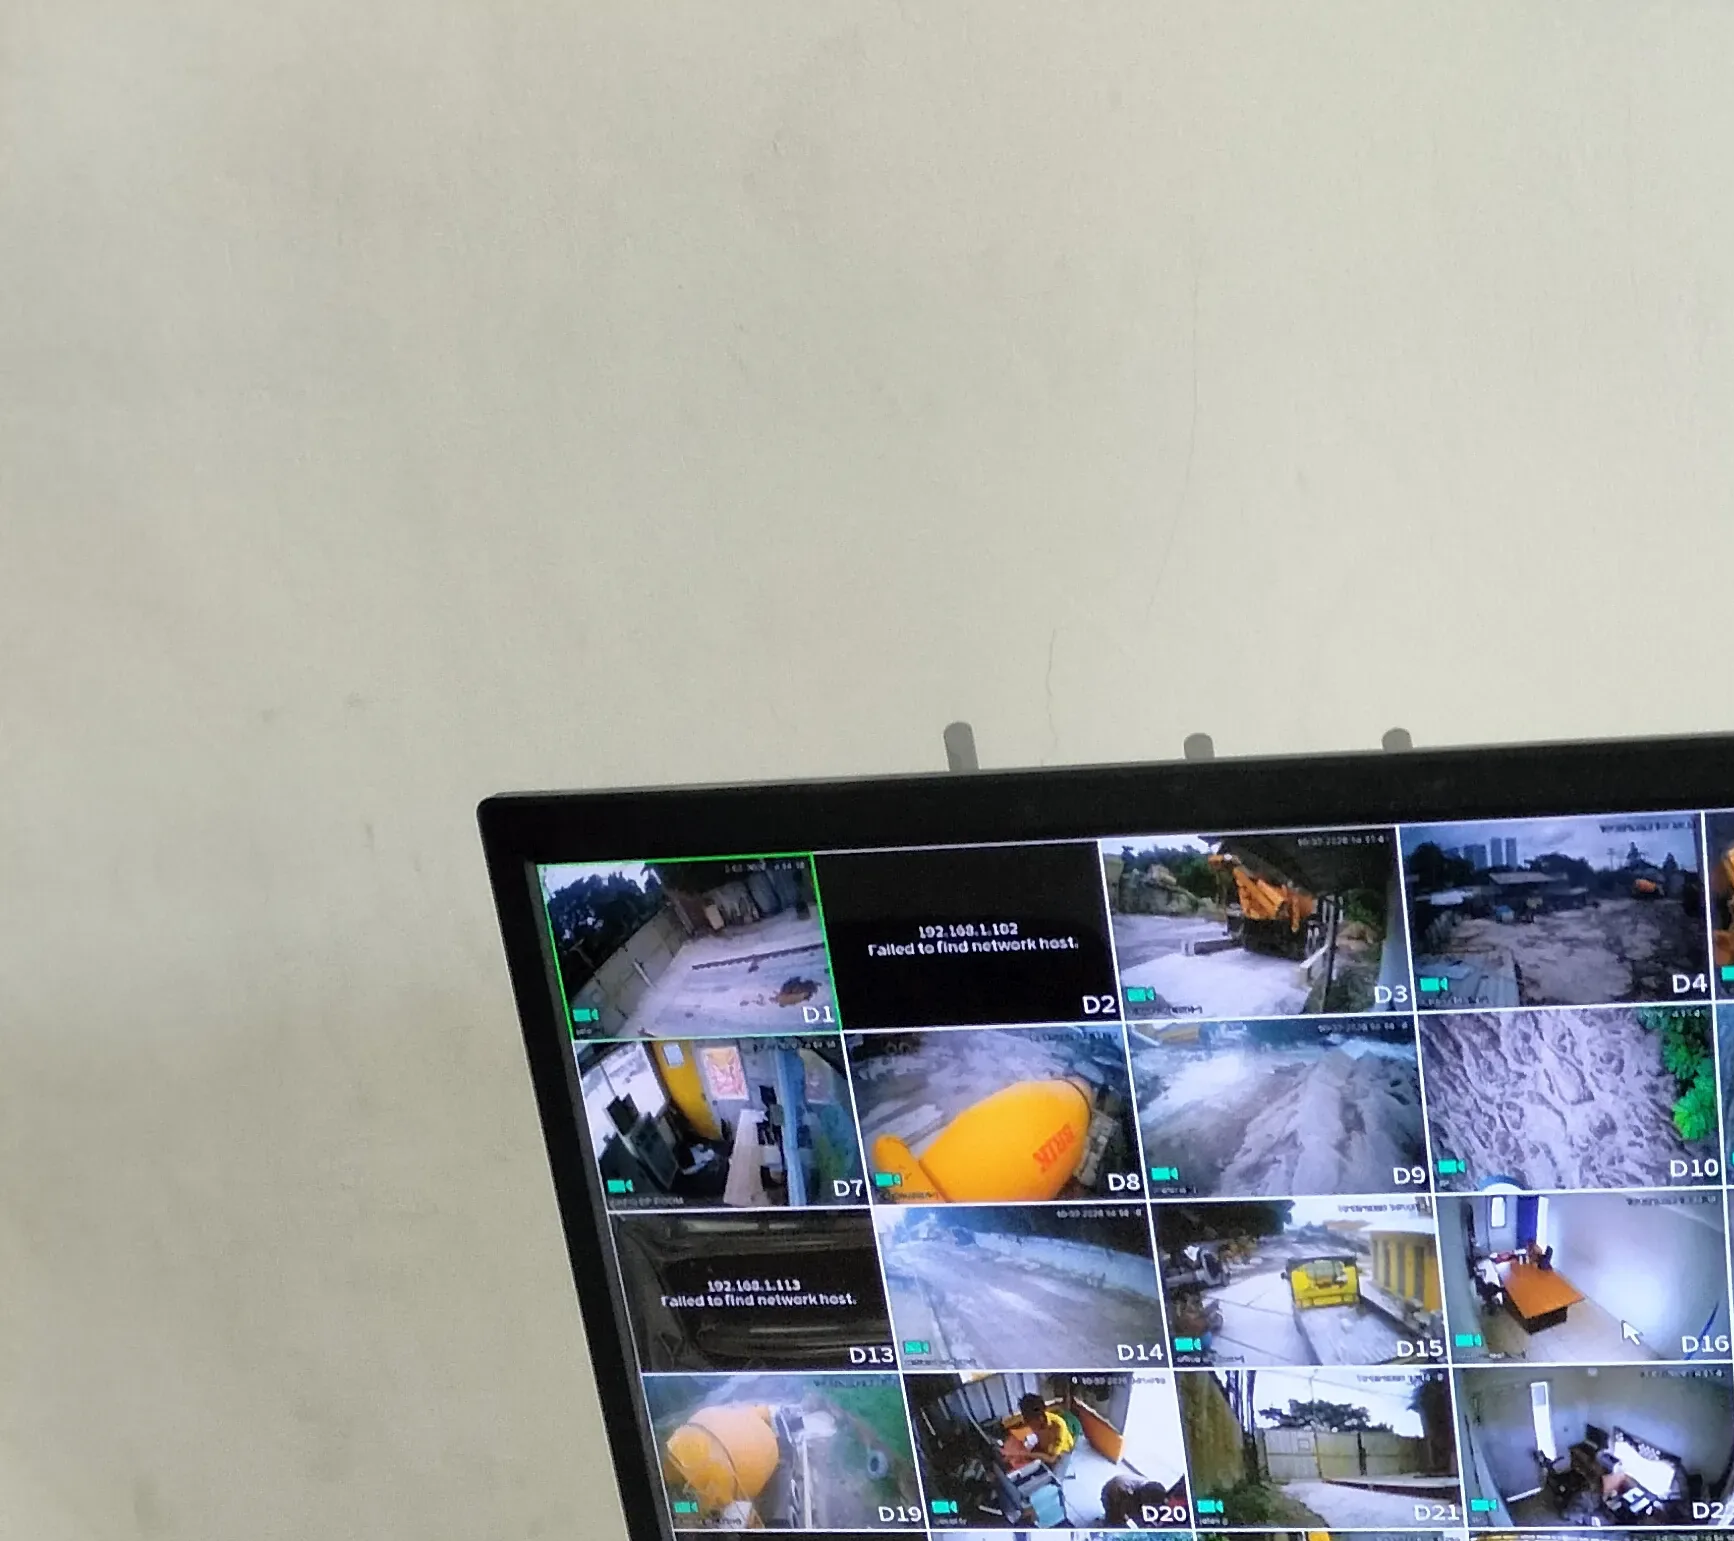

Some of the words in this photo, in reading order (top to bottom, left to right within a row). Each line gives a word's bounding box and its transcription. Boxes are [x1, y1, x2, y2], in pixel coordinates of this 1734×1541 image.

[868, 944, 914, 956] Failed
[918, 942, 934, 954] to
[937, 940, 968, 953] find
[972, 935, 1036, 952] network
[1673, 974, 1707, 993] D4
[1375, 986, 1407, 1003] D3
[1083, 996, 1115, 1013] D2
[803, 1006, 834, 1023] D1
[1393, 1167, 1425, 1184] D9
[1671, 1159, 1718, 1177] D10
[834, 1180, 862, 1196] D7
[1108, 1174, 1140, 1190] D8
[1117, 1344, 1163, 1360] D14
[1397, 1340, 1443, 1357] D15
[1682, 1335, 1729, 1352] D16
[850, 1347, 893, 1363] D13
[879, 1506, 921, 1521] D19
[1142, 1506, 1186, 1522] D20
[1415, 1505, 1459, 1520] D21
